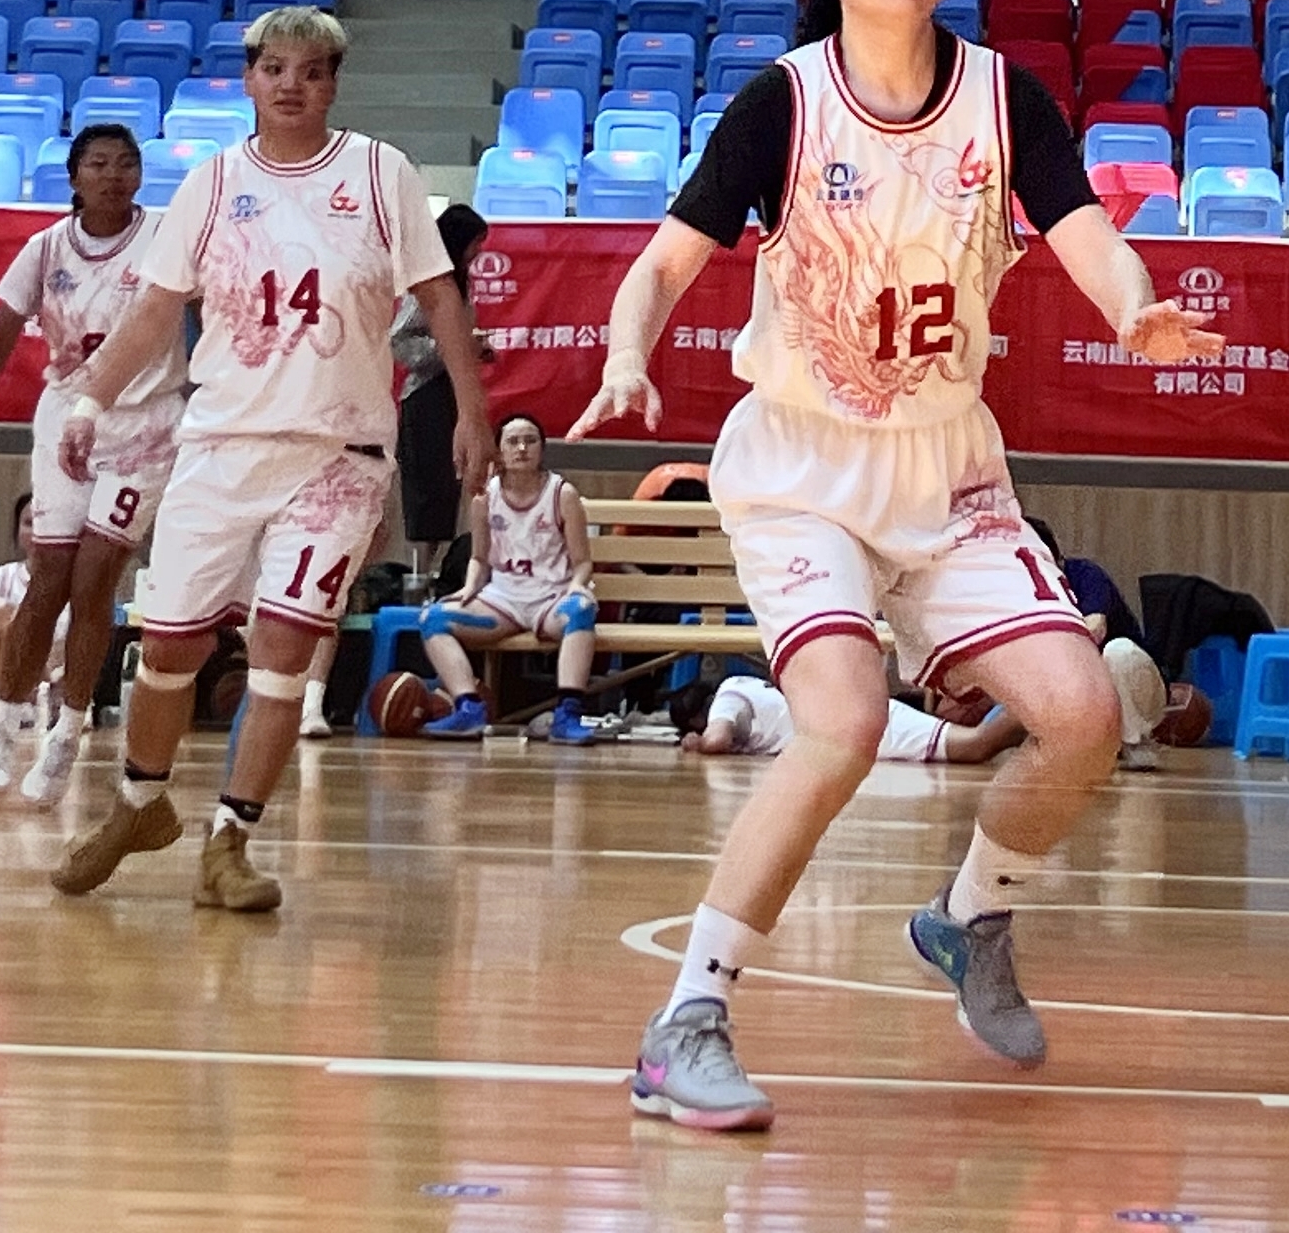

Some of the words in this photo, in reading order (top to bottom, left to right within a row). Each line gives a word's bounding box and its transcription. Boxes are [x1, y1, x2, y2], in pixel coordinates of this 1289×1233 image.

[260, 267, 322, 326] 14
[874, 282, 956, 360] 12
[1154, 371, 1245, 396] 有限公司
[109, 486, 140, 529] 9
[284, 544, 351, 610] 14
